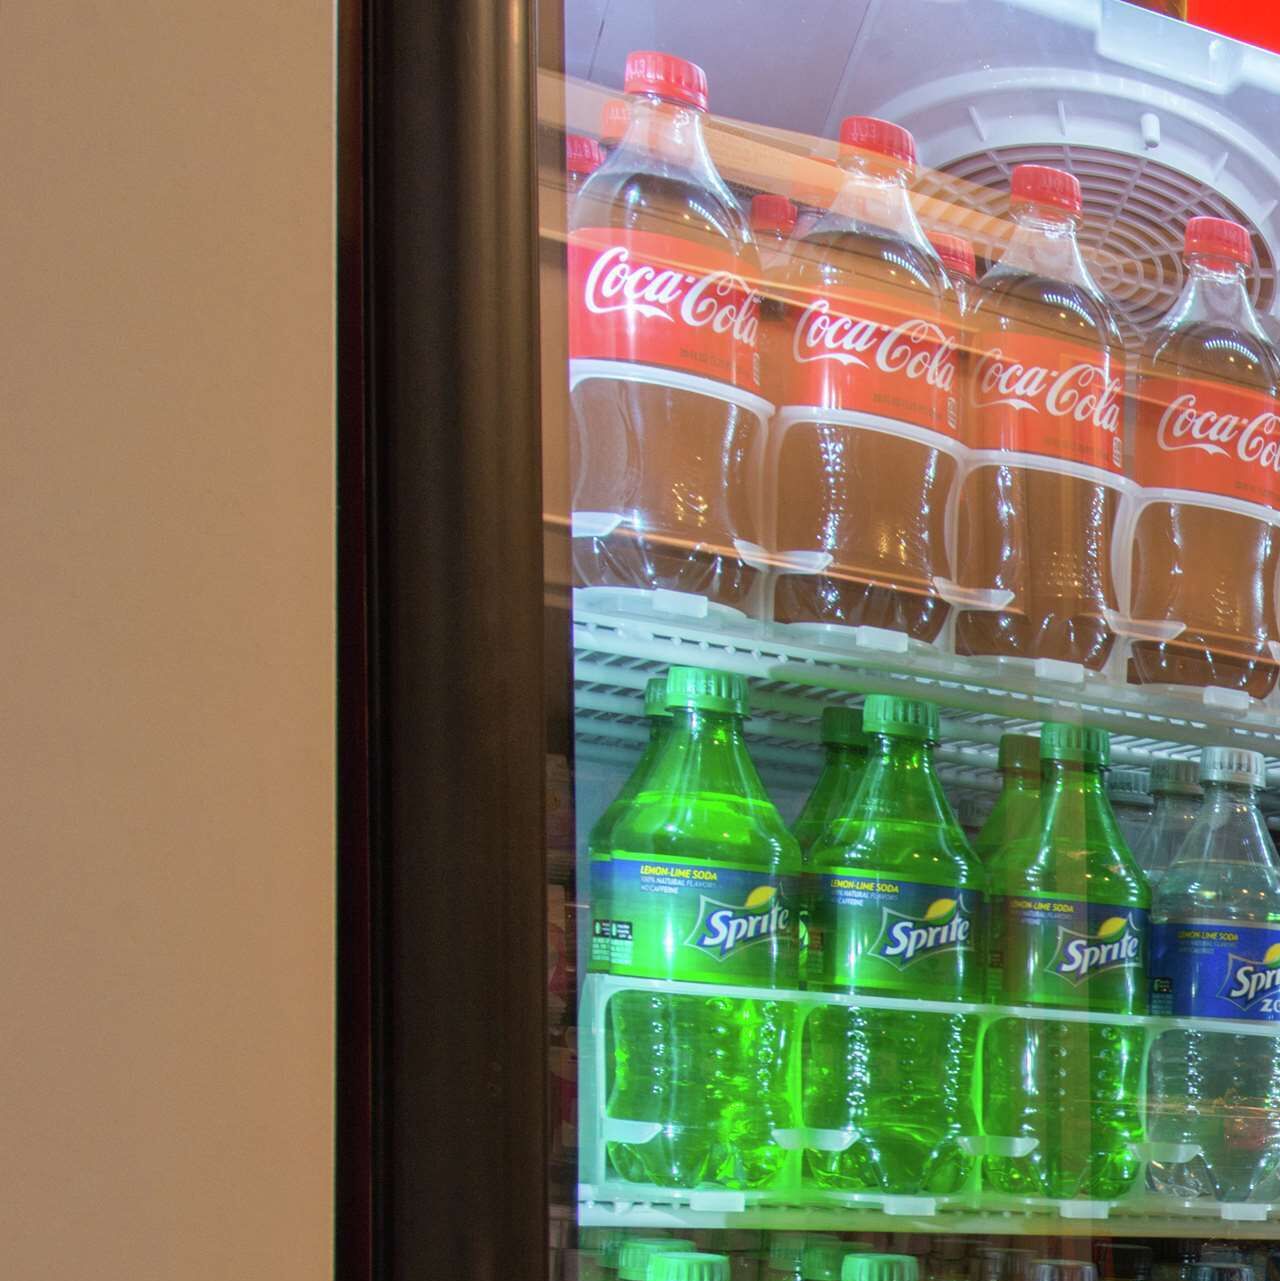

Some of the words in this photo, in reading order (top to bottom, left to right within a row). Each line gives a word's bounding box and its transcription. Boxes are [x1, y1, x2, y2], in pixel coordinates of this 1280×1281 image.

[585, 246, 765, 347] Coca-Cola
[793, 299, 955, 392] Coca-Cola
[970, 348, 1122, 433] Coca-Cola
[640, 865, 691, 879] LEMON-LIME
[692, 870, 718, 881] SODA
[876, 882, 899, 893] SODA
[699, 901, 789, 950] Sprite
[1052, 903, 1075, 913] SODA
[884, 911, 970, 959] Sprite
[1061, 929, 1139, 974] Sprite
